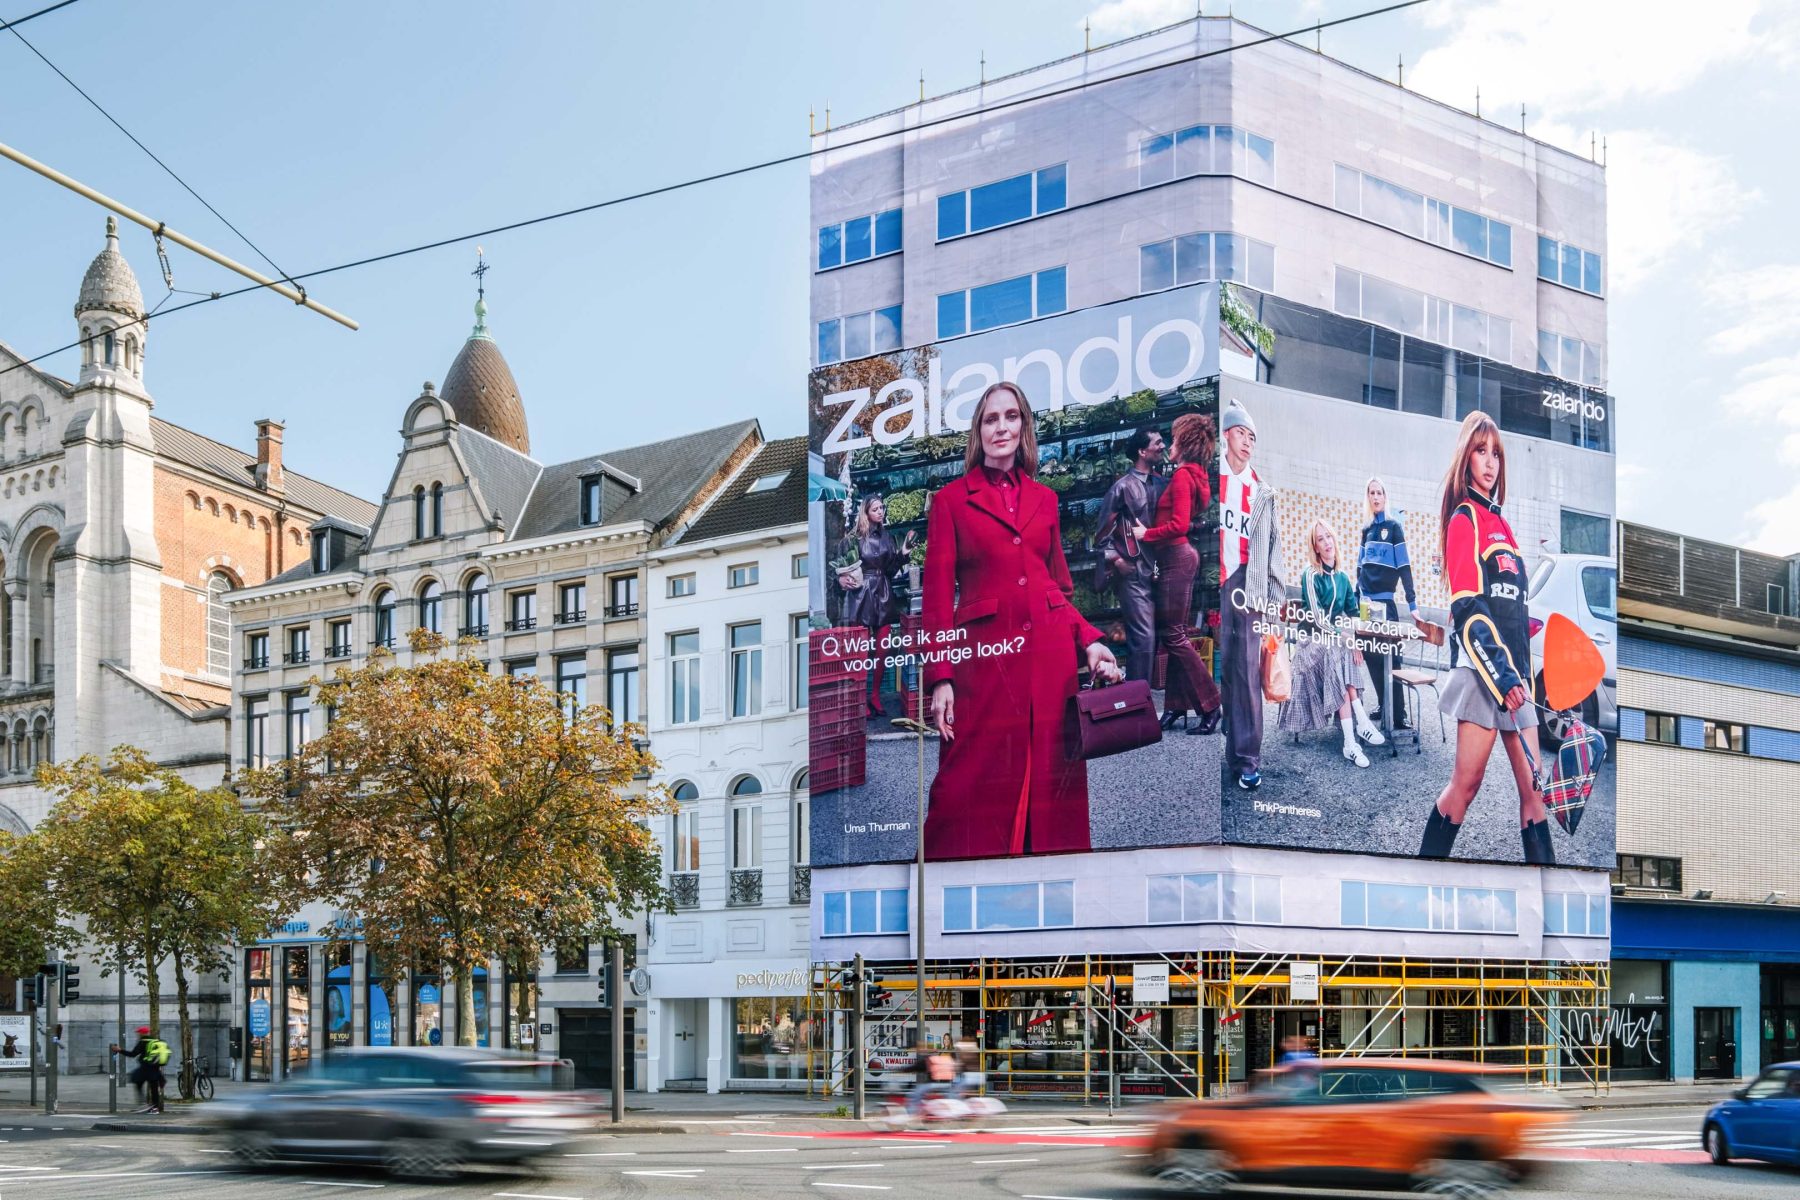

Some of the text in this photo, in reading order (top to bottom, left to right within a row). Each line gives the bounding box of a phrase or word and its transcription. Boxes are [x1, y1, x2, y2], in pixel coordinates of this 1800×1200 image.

[822, 315, 1205, 456] zalando
[1543, 390, 1605, 422] zalando
[1253, 595, 1420, 641] Wat doe ik aan zodat je
[843, 636, 1026, 672] voor een vurige look?
[844, 628, 967, 653] Wat doe ik aan
[1252, 620, 1407, 657] aan me blijft denken?
[1253, 800, 1322, 818] PinkPantheress
[844, 822, 911, 834] Uma Thurman
